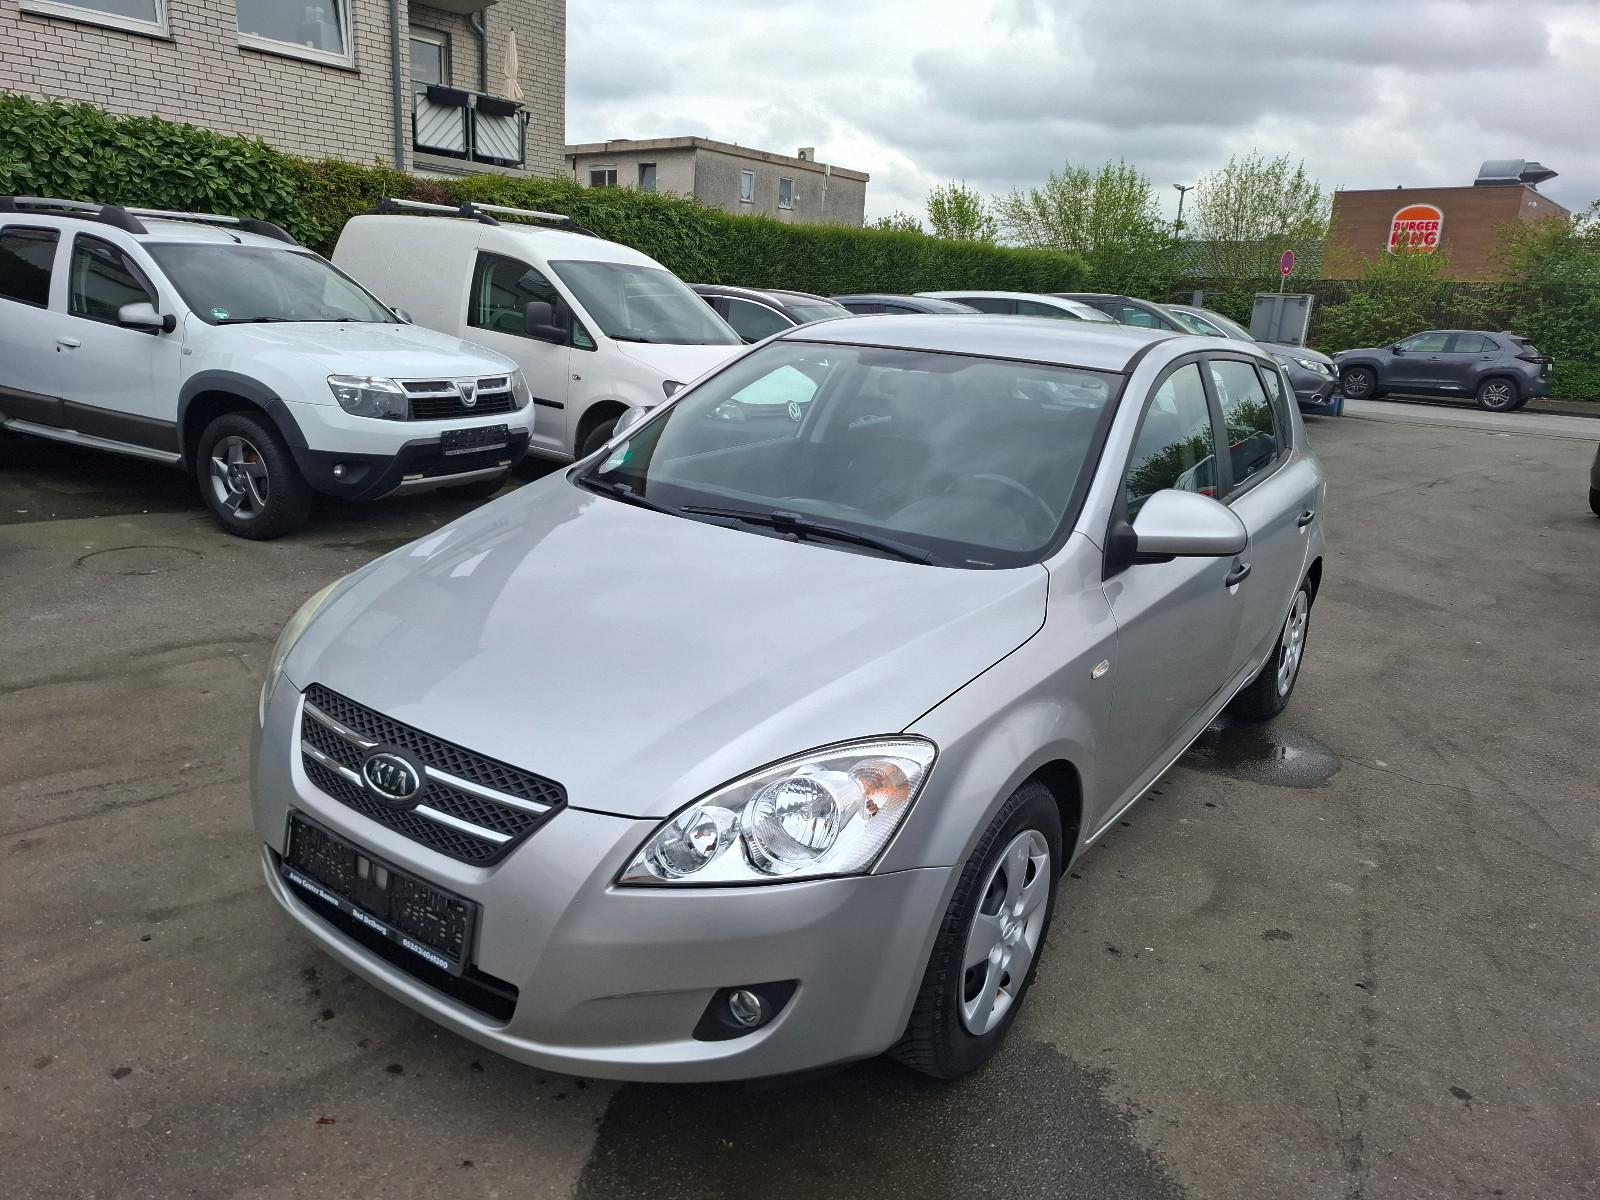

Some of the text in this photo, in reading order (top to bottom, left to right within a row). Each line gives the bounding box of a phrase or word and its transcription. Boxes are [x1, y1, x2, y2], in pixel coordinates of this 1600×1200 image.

[1393, 221, 1439, 231] BURGER
[370, 759, 406, 795] KIA
[352, 908, 363, 920] Bad
